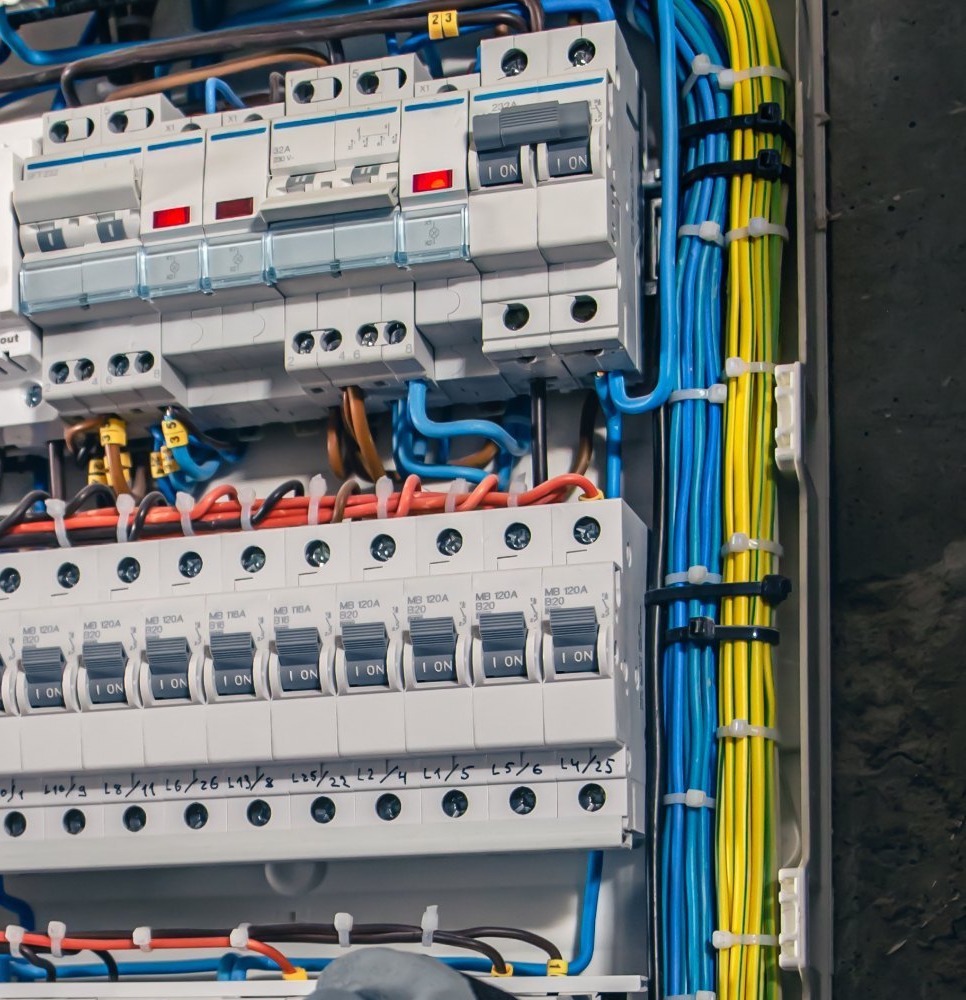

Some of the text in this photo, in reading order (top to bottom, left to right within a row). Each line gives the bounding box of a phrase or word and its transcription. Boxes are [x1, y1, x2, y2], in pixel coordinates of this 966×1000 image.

[432, 13, 452, 24] 2 3
[568, 155, 587, 170] ON
[499, 163, 518, 178] ON
[0, 334, 19, 345] out
[339, 351, 345, 360] 4
[353, 350, 361, 360] 6
[288, 356, 295, 366] 2
[504, 655, 523, 667] ON
[574, 651, 593, 662] ON
[366, 664, 384, 676] ON
[434, 660, 452, 673] ON
[235, 675, 251, 685] ON
[300, 669, 318, 680] ON
[106, 684, 123, 693] ON
[171, 678, 187, 688] ON
[46, 687, 62, 697] ON
[492, 762, 543, 776] L5/6
[560, 755, 616, 774] L4/25
[357, 766, 407, 785] L2/4
[423, 764, 474, 781] L1/5
[166, 776, 219, 793] L6/26
